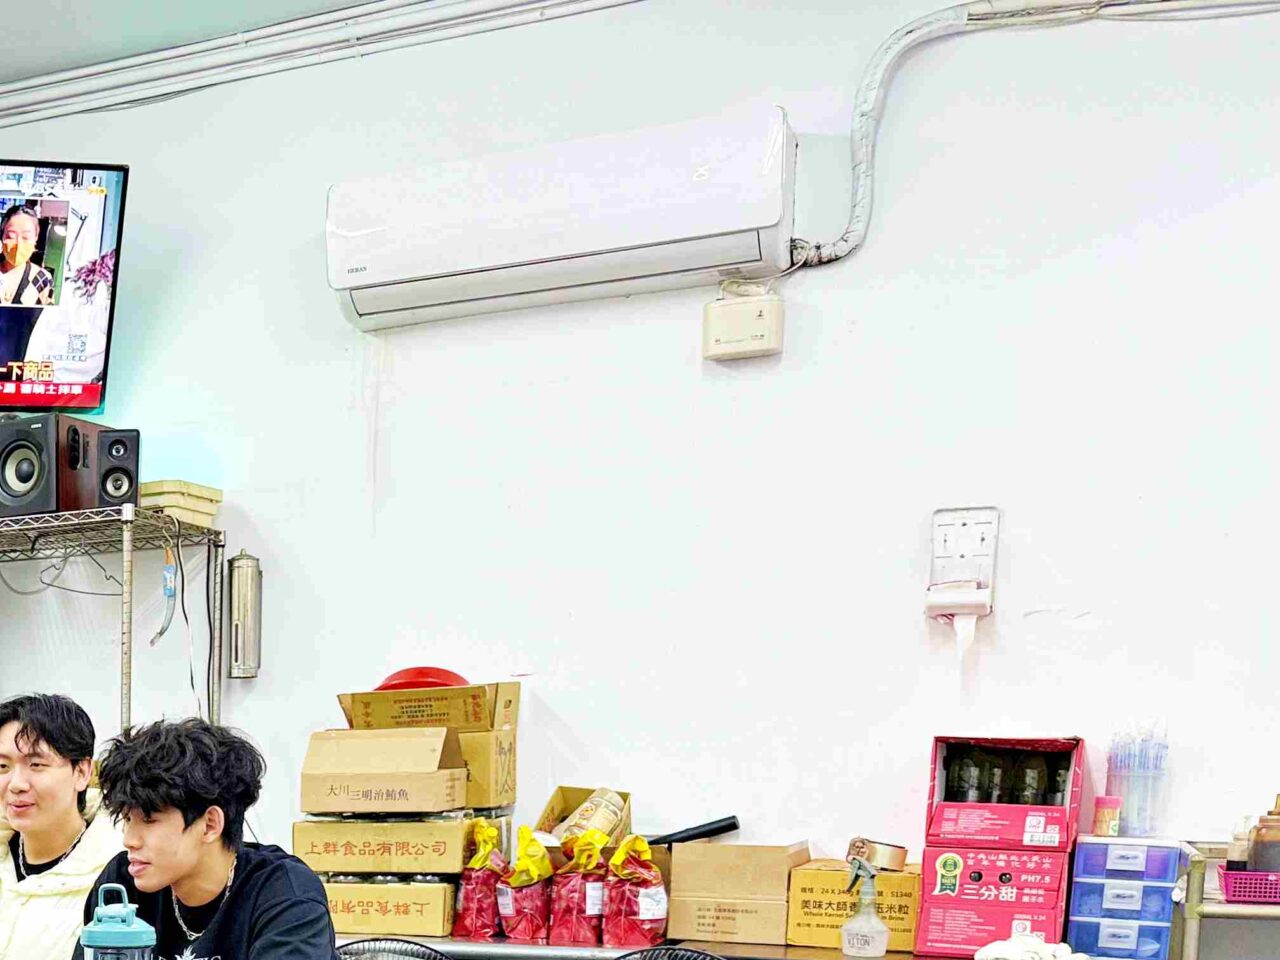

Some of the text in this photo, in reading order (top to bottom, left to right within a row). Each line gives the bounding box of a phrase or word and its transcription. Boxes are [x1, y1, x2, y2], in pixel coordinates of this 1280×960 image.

[327, 784, 409, 802] 大川三明治鮪魚
[304, 840, 447, 857] 上群食品有限公司
[1020, 874, 1051, 883] PH7.5
[960, 884, 1018, 902] 三分甜
